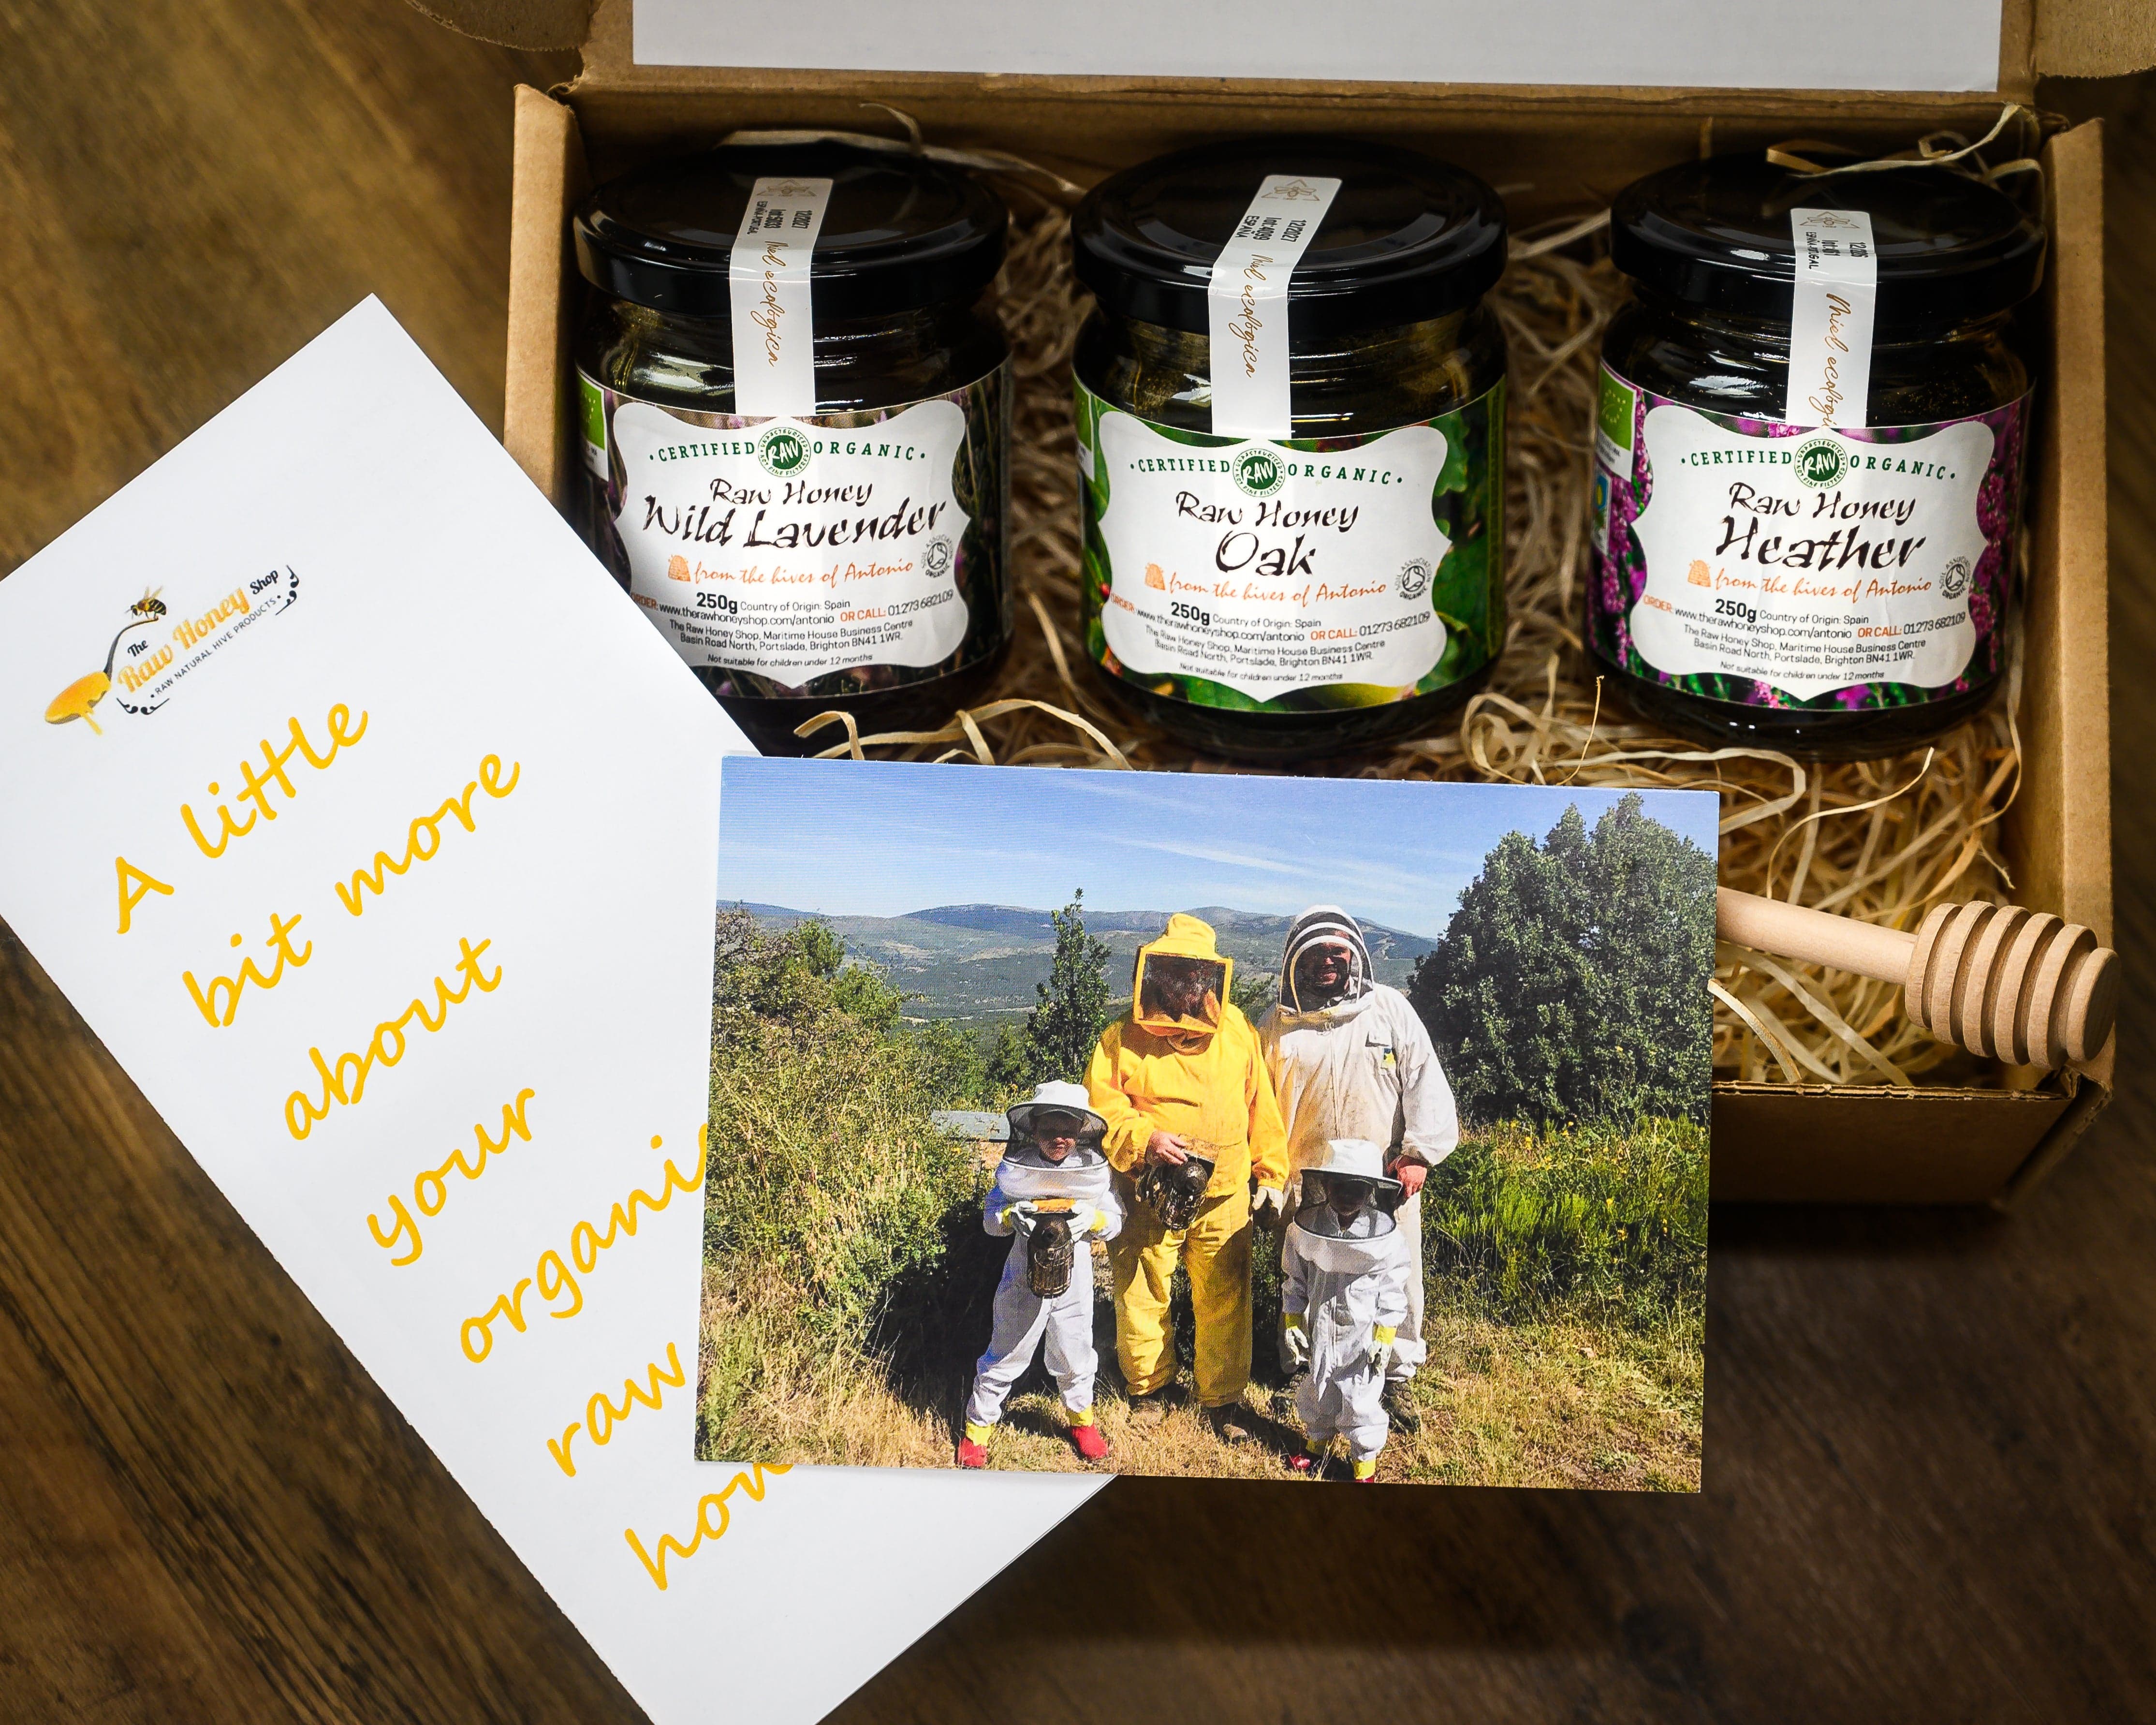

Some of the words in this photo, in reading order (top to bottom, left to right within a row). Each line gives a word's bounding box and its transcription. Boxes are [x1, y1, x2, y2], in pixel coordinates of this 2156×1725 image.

[1234, 215, 1260, 238] ESPAÑA
[1253, 217, 1282, 241] lot:4099
[1280, 219, 1307, 242] 12/2027
[658, 442, 755, 462] CERTIFIED
[813, 441, 914, 460] ORGANIC
[768, 439, 799, 465] RAW
[1691, 450, 1791, 466] CERTIFIED
[1850, 455, 1946, 480] ORGANIC
[1804, 450, 1835, 476] RAW
[1138, 458, 1230, 472] CERTIFIED
[1288, 463, 1391, 485] ORGANIC
[1243, 460, 1273, 485] RAW
[710, 478, 771, 504] Raw
[783, 480, 872, 507] Honey
[1729, 482, 1800, 516] Raw
[1813, 491, 1916, 526] Honey
[643, 495, 735, 546] Wild
[743, 497, 946, 548] Lavender
[1176, 491, 1243, 525] Raw
[1255, 500, 1359, 533] Honey
[1216, 531, 1316, 576] Oak
[1716, 515, 1926, 572] Heather
[249, 570, 279, 596] Shop
[694, 561, 735, 584] from
[740, 565, 765, 584] the
[771, 566, 815, 584] hives
[820, 564, 838, 589] of
[844, 558, 913, 582] Antonio
[1715, 568, 1757, 590] from
[1762, 575, 1789, 592] the
[1793, 577, 1837, 597] hives
[1841, 579, 1862, 604] of
[1866, 577, 1932, 598] Antonio
[696, 592, 738, 614] 250g
[740, 601, 777, 612] Country
[780, 602, 790, 611] of
[792, 602, 821, 613] Origin:
[824, 600, 851, 611] Spain
[1169, 572, 1208, 594] from
[1213, 581, 1237, 598] the
[1242, 582, 1285, 601] hives
[1292, 584, 1310, 607] of
[1316, 580, 1386, 602] Antonio
[173, 587, 250, 650] Honey
[660, 604, 834, 627] www.therawhoneyshop.com/antonio
[840, 610, 855, 622] OR
[857, 607, 886, 619] CALL:
[888, 600, 919, 617] 01273
[920, 589, 954, 608] 682109
[1171, 602, 1210, 626] 250g
[1213, 613, 1248, 627] Country
[1250, 618, 1260, 627] of
[1295, 619, 1321, 629] Spain
[1675, 607, 1852, 638] www.therawhoneyshop.com/antonio
[1858, 627, 1872, 638] OR
[1874, 625, 1902, 637] CALL:
[1904, 619, 1934, 635] 01273
[1935, 611, 1966, 630] 682109
[1715, 598, 1757, 623] 250g
[1760, 609, 1797, 624] Country
[1800, 614, 1809, 623] of
[1812, 615, 1841, 625] Origin:
[1844, 616, 1869, 626] Spain
[670, 619, 685, 632] The
[686, 622, 704, 634] Raw
[705, 626, 733, 640] Honey
[763, 630, 805, 640] Maritime
[807, 628, 838, 639] House
[840, 626, 881, 637] Business
[883, 619, 913, 631] Centre
[1310, 630, 1325, 640] OR
[1328, 627, 1357, 639] CALL:
[1359, 621, 1393, 636] 01273
[1393, 611, 1431, 630] 682109
[1684, 624, 1699, 635] The
[1701, 628, 1719, 640] Raw
[1721, 634, 1748, 649] Honey
[1780, 642, 1821, 653] Maritime
[1824, 645, 1854, 654] House
[1856, 643, 1896, 653] Business
[1898, 639, 1926, 650] Centre
[127, 639, 149, 657] The
[156, 678, 174, 695] RAW
[175, 649, 213, 680] NATURAL
[213, 631, 233, 650] HIVE
[233, 596, 277, 633] PRODUCTS
[680, 633, 703, 645] Basin
[705, 636, 727, 648] Road
[729, 640, 757, 651] North,
[759, 641, 807, 651] Portslade,
[810, 640, 850, 651] Brighton
[851, 635, 876, 647] BN41
[1178, 634, 1204, 649] Honey
[1234, 644, 1276, 655] Maritime
[1277, 646, 1308, 655] House
[1310, 644, 1352, 655] Business
[1354, 639, 1385, 651] Centre
[1694, 638, 1717, 651] Basin
[1719, 643, 1742, 656] Road
[1744, 649, 1772, 661] North,
[1775, 653, 1822, 664] Portslade,
[1825, 655, 1864, 666] Brighton
[1866, 653, 1890, 663] BN41
[117, 644, 174, 693] Raw
[707, 654, 721, 663] Not
[723, 657, 754, 666] suitable
[757, 658, 768, 666] for
[770, 657, 802, 666] children
[804, 657, 827, 666] under
[830, 656, 840, 665] 12
[842, 654, 873, 664] months
[1279, 655, 1320, 667] Brighton
[1322, 655, 1347, 665] BN41
[1720, 661, 1734, 670] Not
[1736, 665, 1768, 675] suitable
[1770, 668, 1781, 677] for
[1783, 670, 1816, 679] children
[1855, 671, 1884, 680] months
[116, 856, 174, 934] A
[180, 703, 368, 858] little
[182, 913, 312, 1028] bit
[335, 753, 520, 916] more
[284, 937, 502, 1140] about
[367, 1087, 535, 1267] your
[460, 1122, 708, 1363] organi
[546, 1342, 686, 1477] raw
